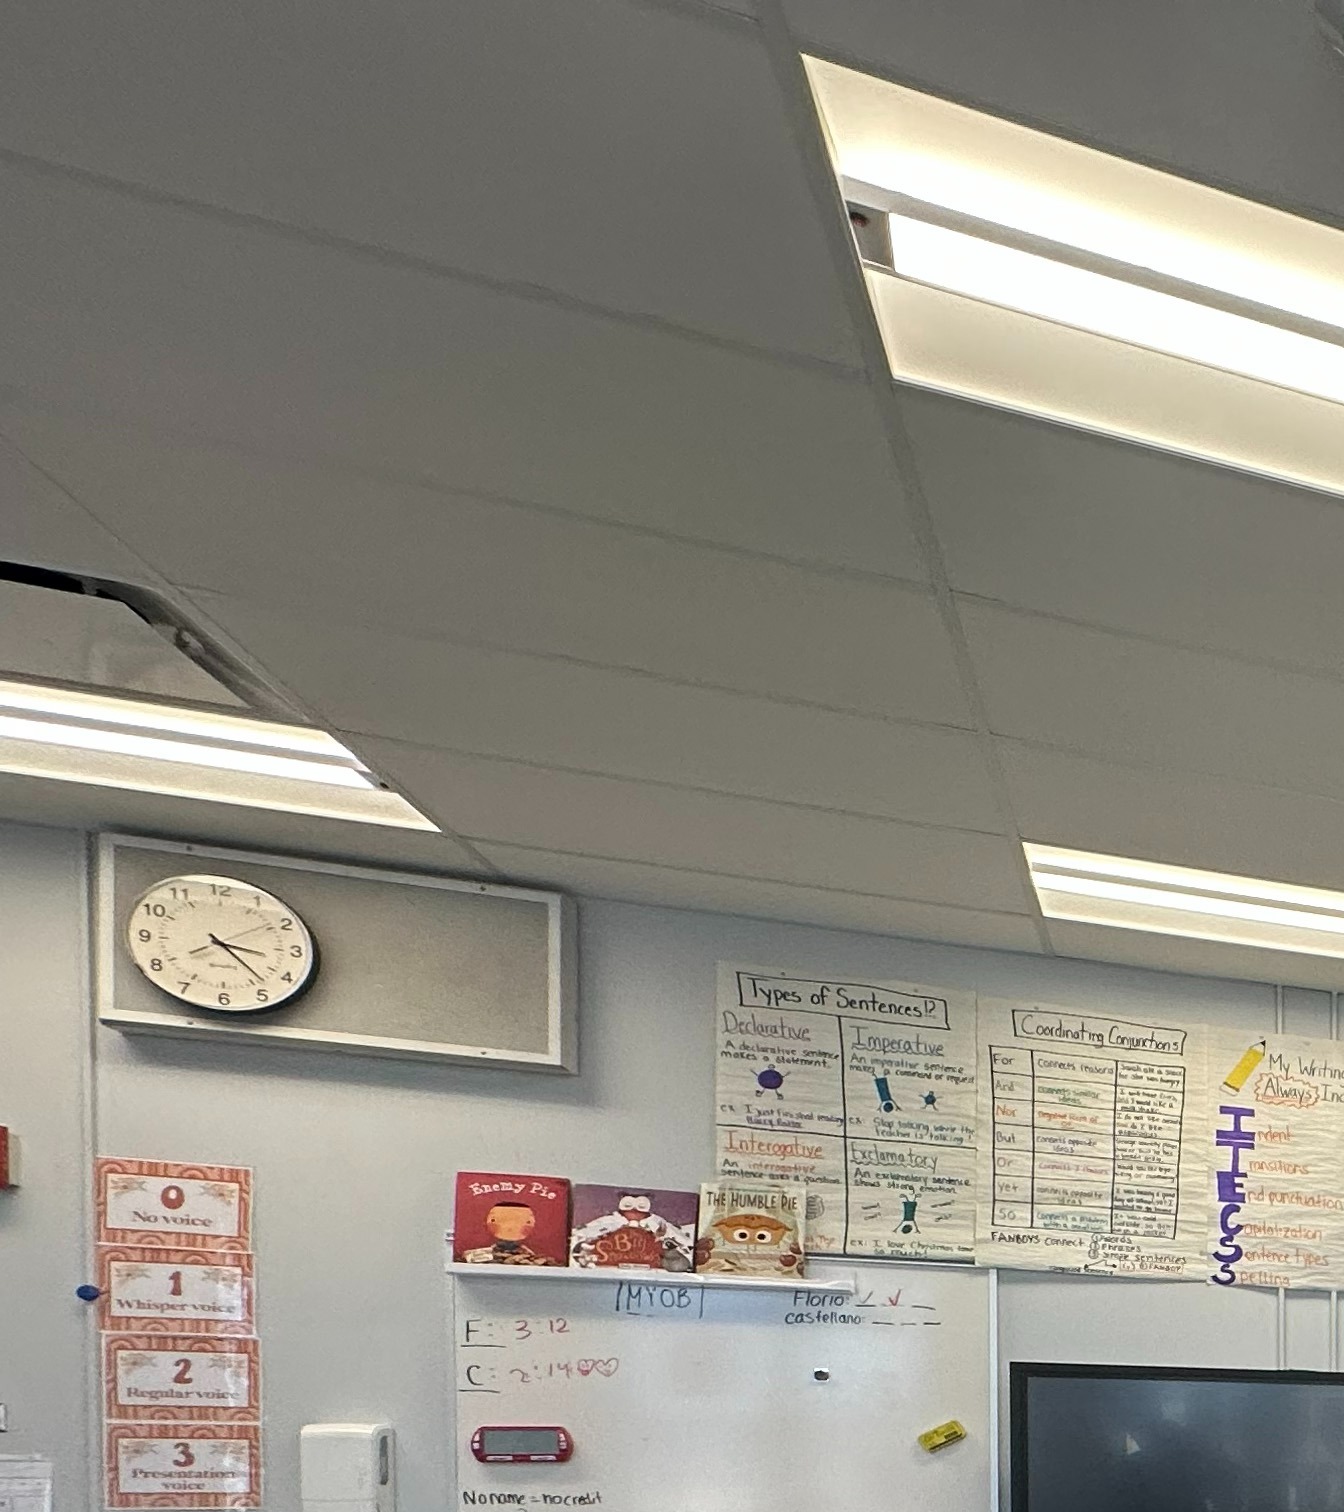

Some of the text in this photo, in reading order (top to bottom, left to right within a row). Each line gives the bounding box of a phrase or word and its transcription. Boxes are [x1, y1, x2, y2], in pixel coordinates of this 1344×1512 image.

[169, 887, 190, 902] 11
[210, 884, 232, 898] 12
[254, 895, 261, 907] 1
[144, 903, 166, 918] 10
[281, 918, 293, 931] 2
[139, 928, 151, 942] 9
[290, 945, 303, 958] 3
[151, 958, 163, 972] 8
[281, 971, 293, 984] 4
[179, 981, 191, 994] 7
[256, 988, 269, 1002] 5
[747, 977, 802, 1004] Types
[811, 986, 832, 1006] of
[218, 993, 231, 1006] 6
[722, 1011, 811, 1042] Declarative
[1021, 1014, 1179, 1053] Coordinating Conjunctions
[725, 1040, 736, 1050] A
[739, 1042, 797, 1056] declarative
[851, 1026, 945, 1057] Imperative
[721, 1050, 758, 1061] makes
[992, 1053, 1016, 1067] For
[850, 1053, 867, 1064] An
[924, 1063, 964, 1074] sentence
[1268, 1053, 1291, 1075] My
[995, 1078, 1016, 1093] And
[1264, 1078, 1314, 1102] Always
[996, 1104, 1017, 1119] Nor
[996, 1130, 1016, 1144] But
[724, 1131, 824, 1161] Interogative
[723, 1158, 739, 1168] An
[850, 1141, 939, 1175] Exclamatory
[997, 1156, 1014, 1169] Or
[721, 1168, 764, 1180] sentence
[854, 1167, 871, 1179] An
[468, 1181, 558, 1201] Enemy Pie
[887, 1180, 915, 1195] strong
[160, 1184, 185, 1211] 0
[706, 1191, 798, 1211] THE HUMBLE PIE
[1268, 1188, 1344, 1211] punctuation
[132, 1211, 214, 1229] No voice
[991, 1231, 1041, 1245] FANBOYS
[1295, 1249, 1330, 1268] types
[167, 1271, 183, 1297] 1
[626, 1287, 693, 1310] MYOB
[116, 1298, 237, 1315] Whisper voice
[514, 1316, 572, 1341] 3:12
[172, 1357, 194, 1385] 2
[127, 1386, 240, 1402] Regular voice
[172, 1441, 196, 1468] 3
[131, 1467, 237, 1480] Presentation
[160, 1479, 206, 1491] voice
